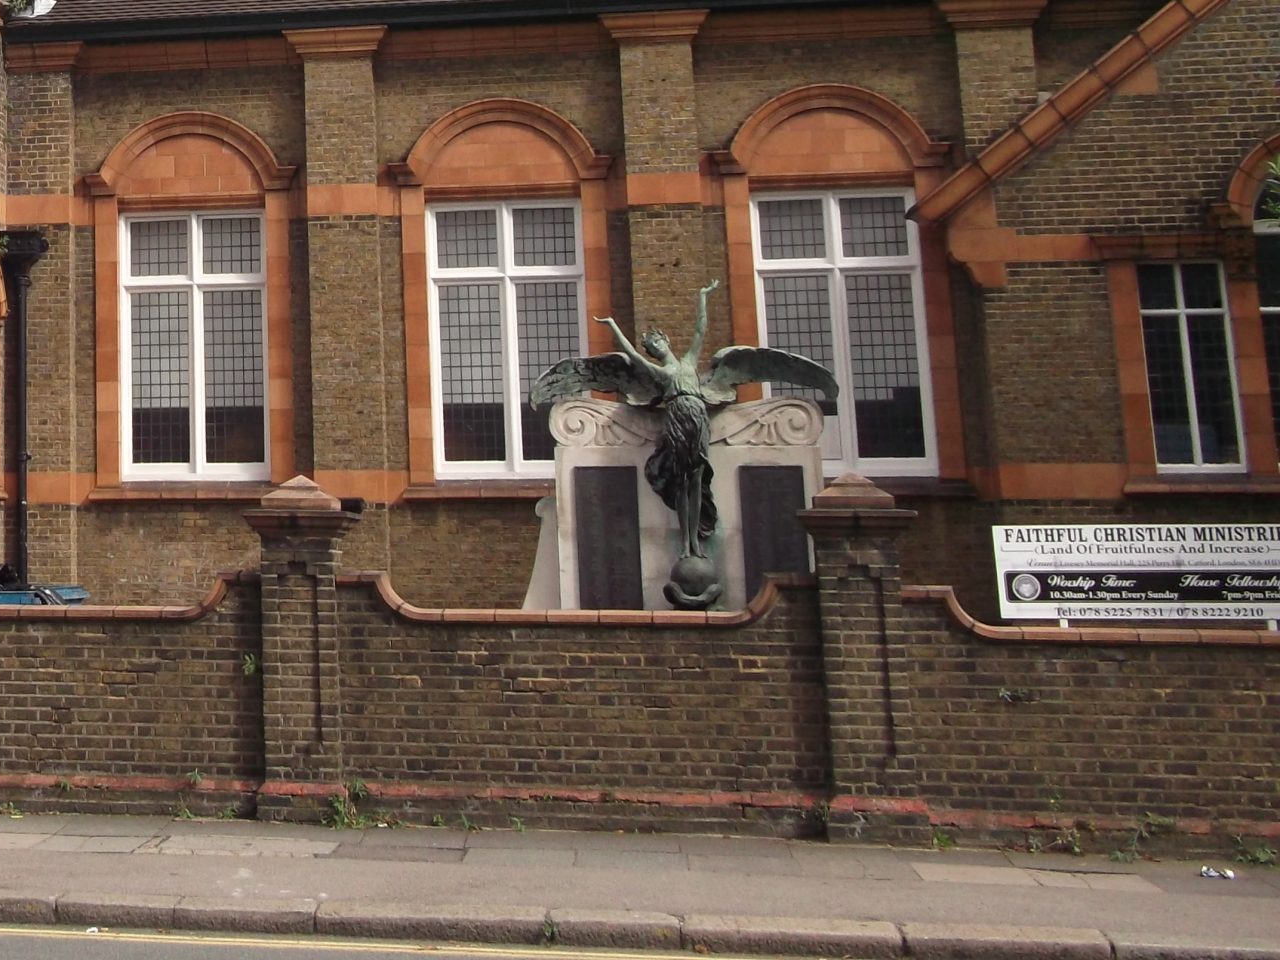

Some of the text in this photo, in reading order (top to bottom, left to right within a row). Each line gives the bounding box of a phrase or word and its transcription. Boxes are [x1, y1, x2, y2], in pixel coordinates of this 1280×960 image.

[1004, 528, 1088, 543] FAITHFUL
[1093, 527, 1186, 542] CHRISTIAN
[1034, 543, 1270, 555] (Land Of Fruitfulness And Increase)
[1047, 574, 1096, 591] Worship
[1179, 573, 1280, 590] House Fellowshi
[1049, 590, 1179, 601] 10.30am-1.30pm Every Sunday
[1221, 590, 1264, 600] 7pm-9pm
[1054, 607, 1264, 617] Tel: 078 5225 7831 / 078 8222 9210
